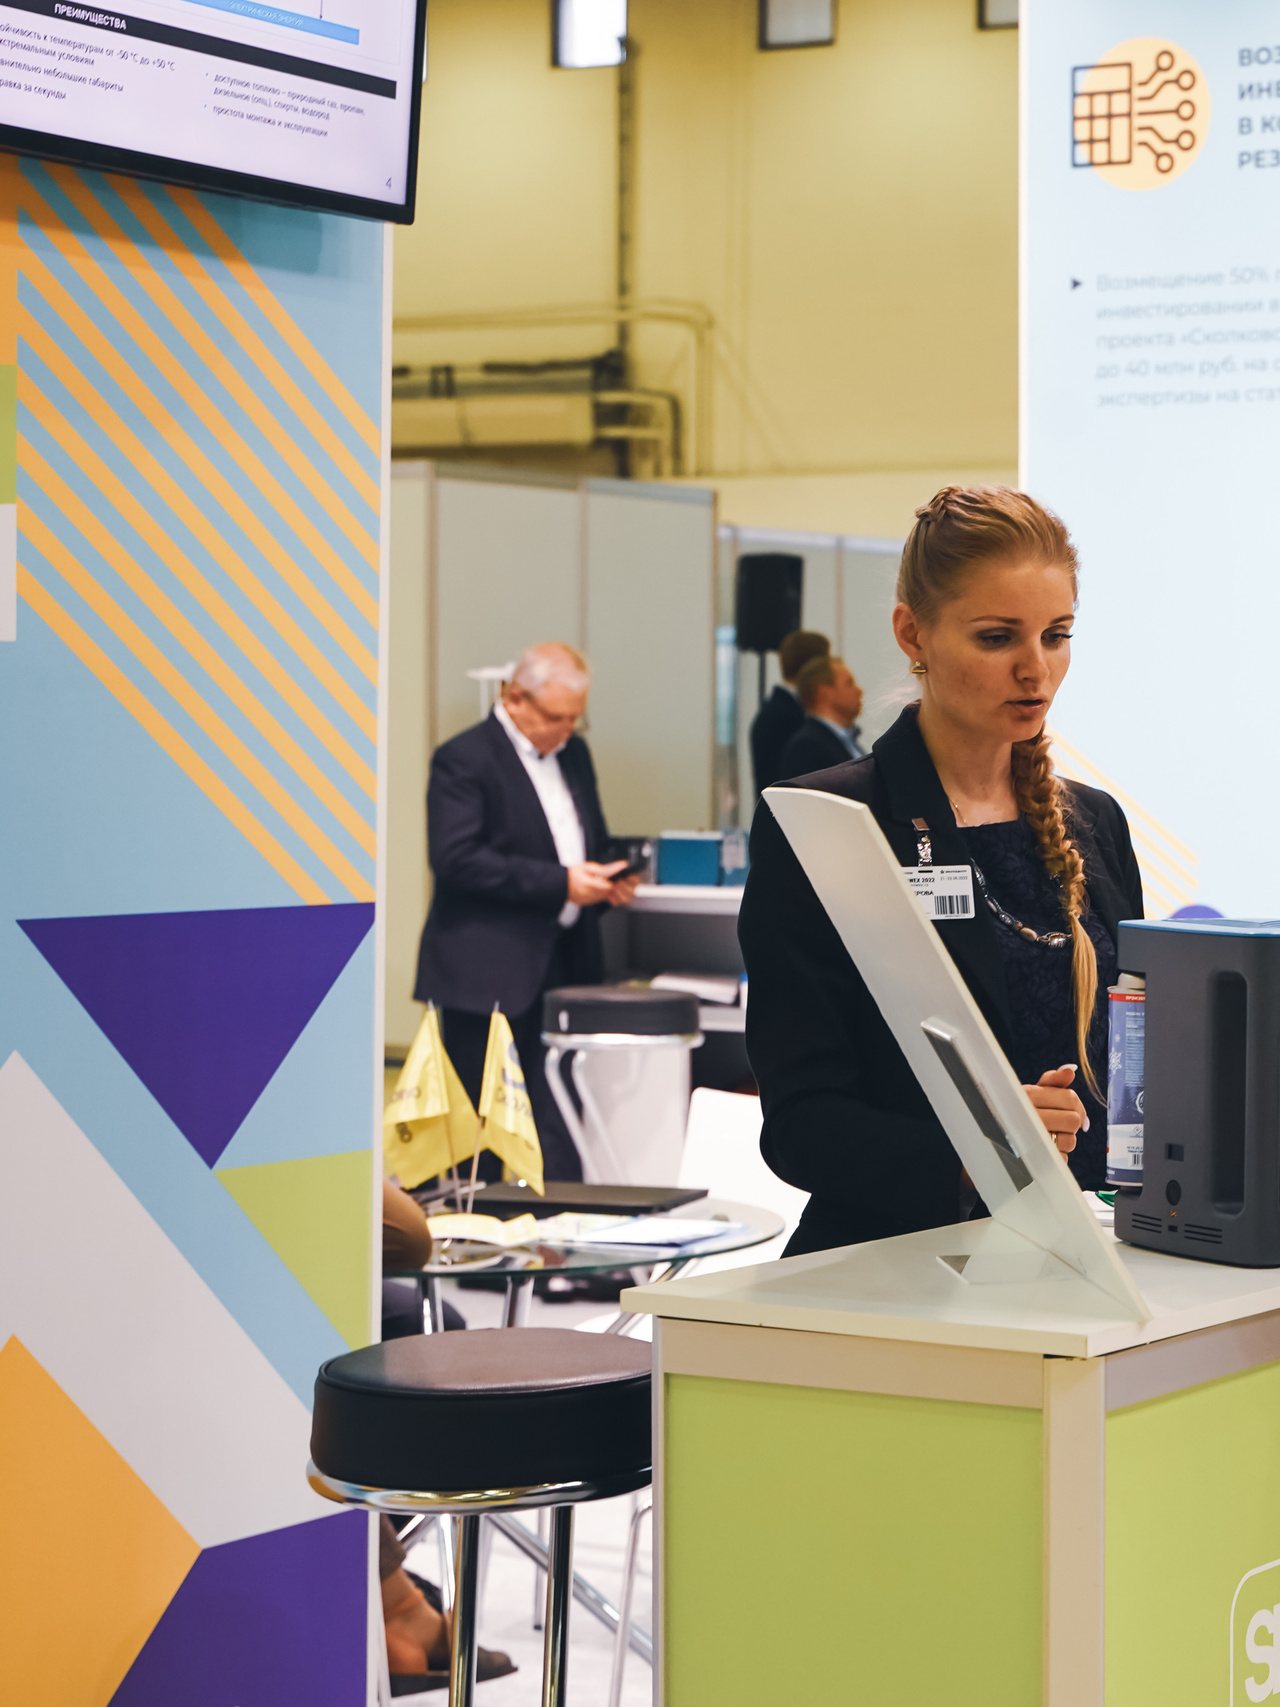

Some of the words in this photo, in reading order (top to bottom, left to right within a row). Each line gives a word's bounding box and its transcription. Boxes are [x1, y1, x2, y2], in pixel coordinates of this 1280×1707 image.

[54, 3, 127, 30] ПРЕИМУЩЕСТВА
[50, 35, 104, 54] температурам
[105, 48, 114, 56] от
[139, 57, 150, 66] до
[58, 51, 95, 66] условиям
[23, 83, 33, 92] за
[33, 86, 67, 100] секунды
[43, 67, 87, 84] небольшие
[88, 77, 124, 92] габариты
[214, 74, 250, 87] доступное
[252, 82, 281, 96] топливо
[287, 90, 326, 106] природный
[213, 87, 250, 101] дизельное
[213, 105, 245, 119] простота
[246, 113, 276, 126] монтажа
[284, 122, 328, 137] эксплуатации
[1238, 117, 1253, 135] В
[385, 177, 393, 190] 4
[1096, 270, 1226, 292] Возмещение
[1229, 266, 1270, 285] 50%
[1096, 299, 1265, 321] инвестировании
[1269, 299, 1280, 312] в
[1096, 331, 1176, 352] проекта
[1095, 362, 1120, 380] до
[1124, 359, 1150, 377] 40
[1154, 361, 1195, 375] млн
[1199, 354, 1238, 378] руб.
[1243, 357, 1268, 373] на
[1096, 386, 1211, 410] экспертизы
[1215, 388, 1240, 403] на
